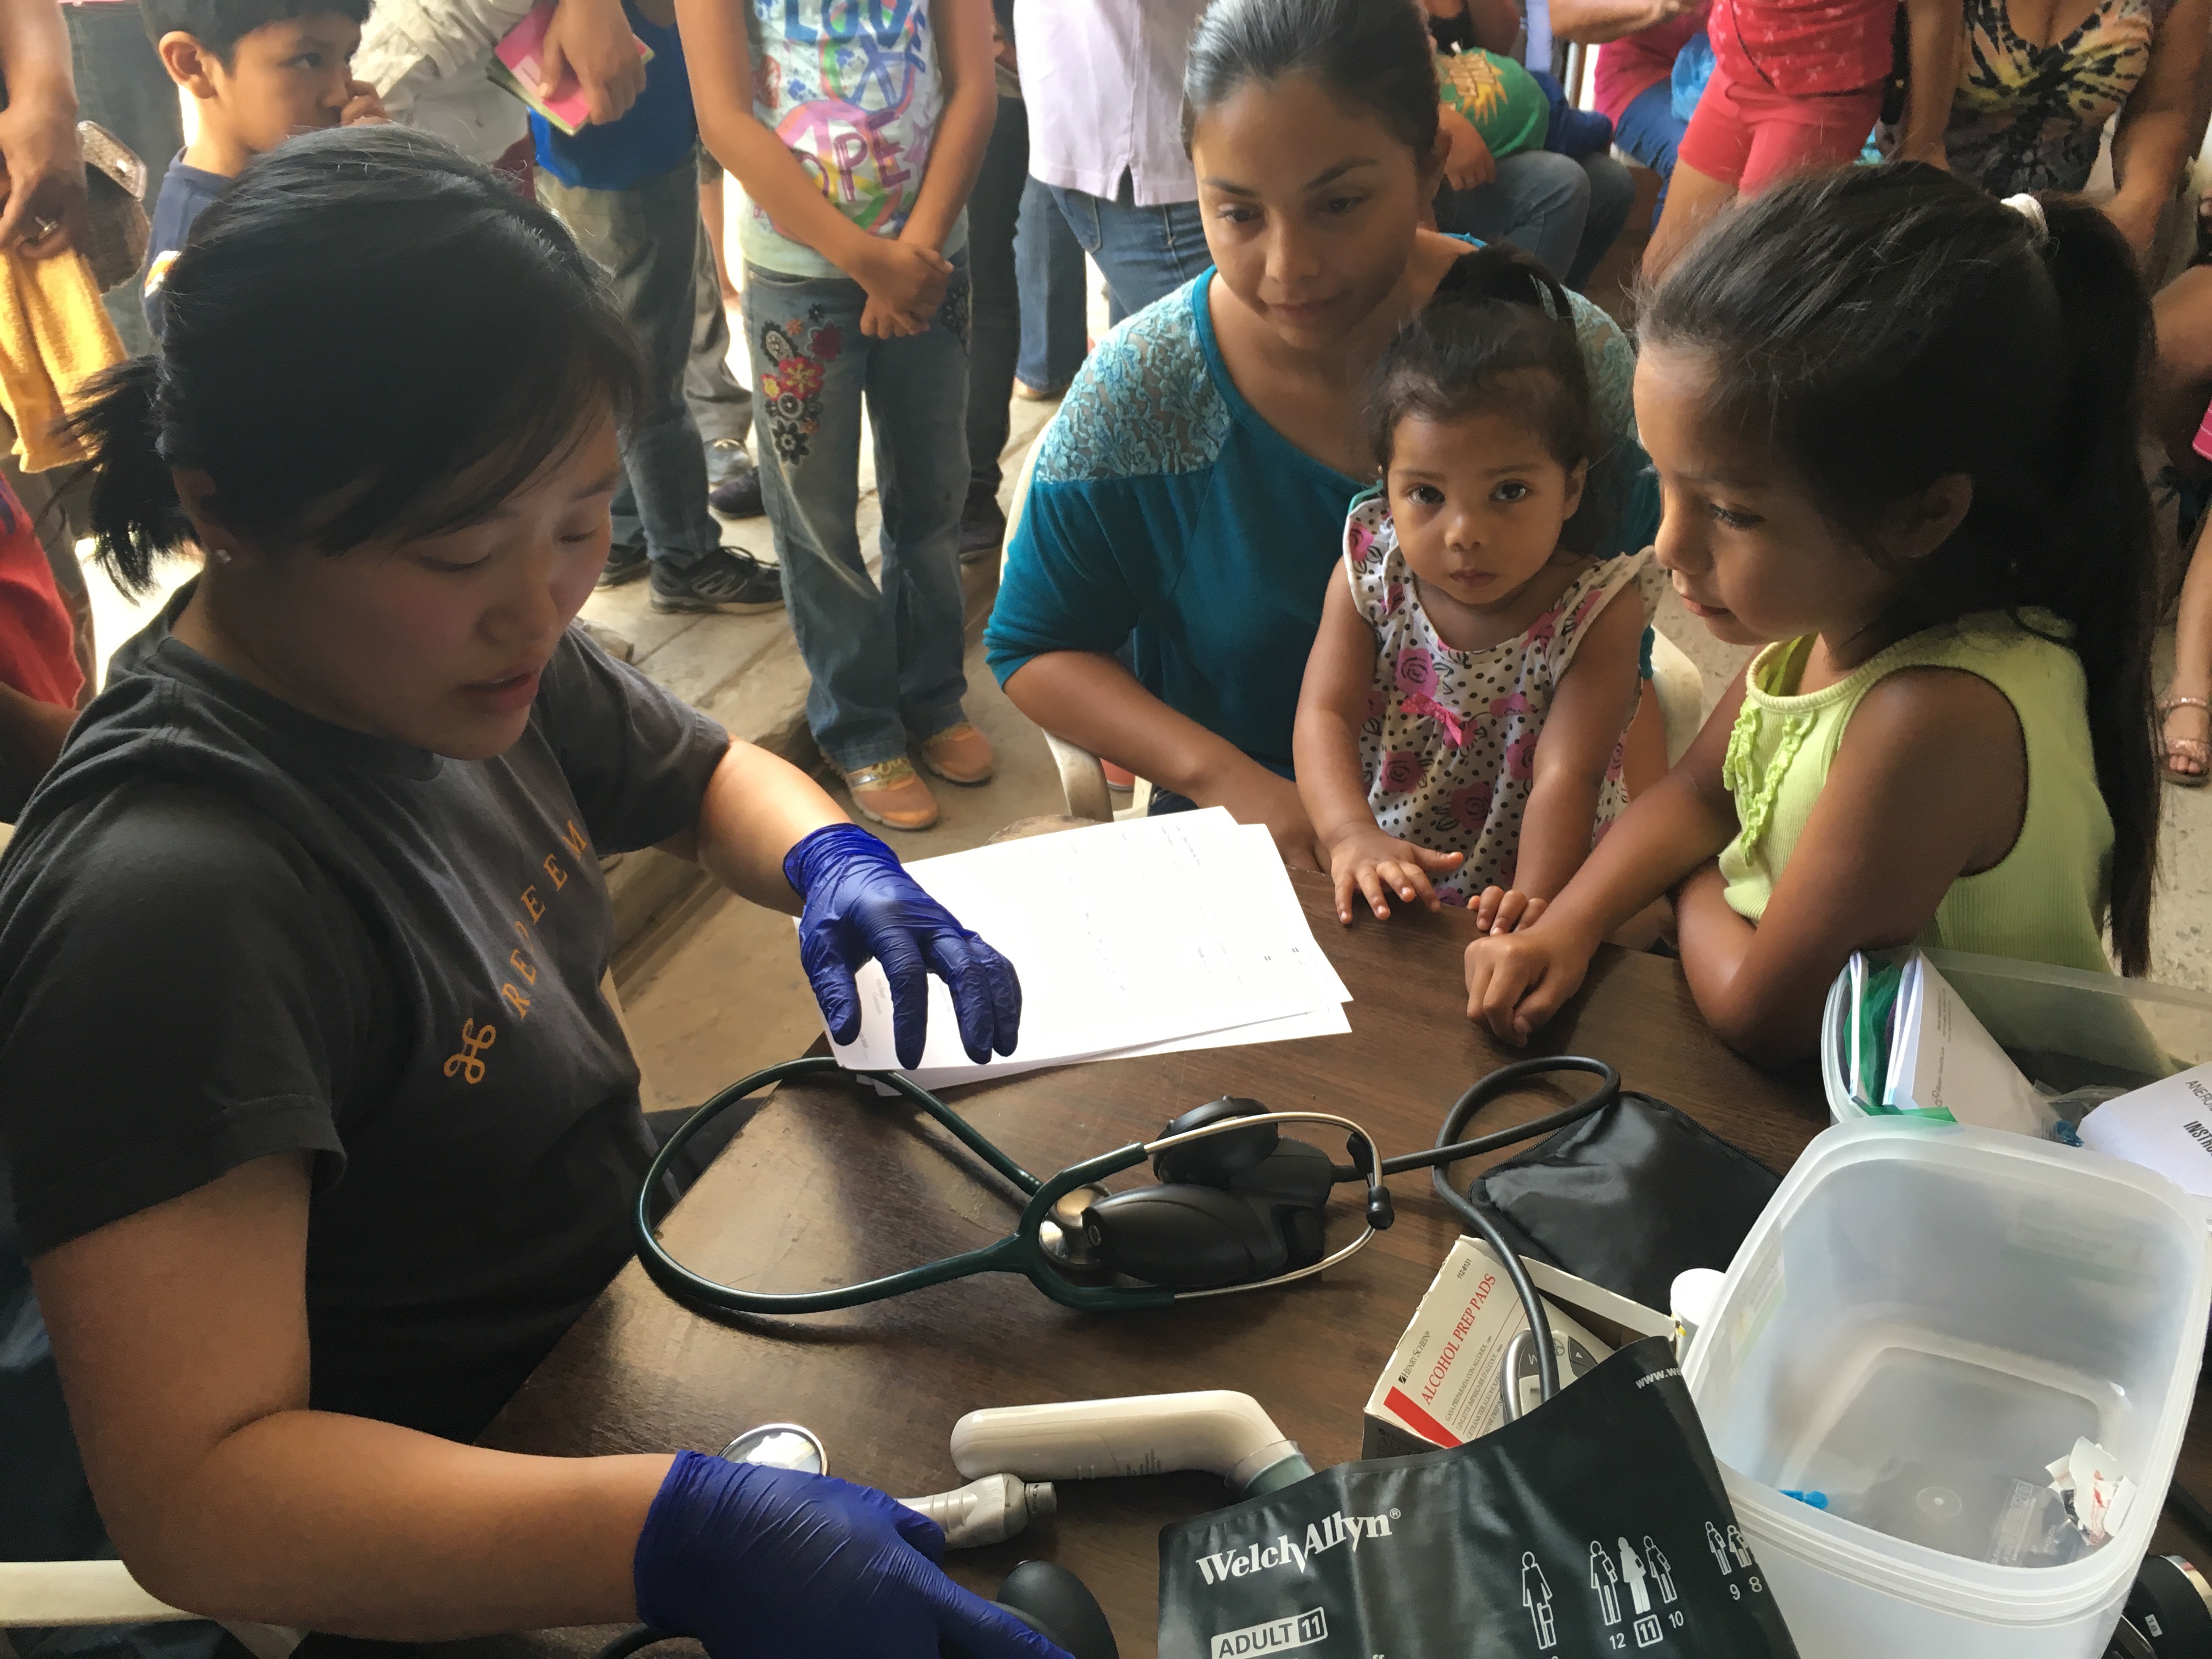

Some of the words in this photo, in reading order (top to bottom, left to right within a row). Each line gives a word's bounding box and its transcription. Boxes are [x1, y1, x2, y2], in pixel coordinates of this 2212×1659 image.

[1457, 1258, 1472, 1279] 112-6131
[1421, 1341, 1460, 1406] ALCOHOL
[1453, 1307, 1476, 1342] PREP
[1469, 1273, 1496, 1311] PADS
[1445, 1406, 1455, 1421] GASA
[1451, 1378, 1470, 1408] PREPARADA
[1466, 1366, 1475, 1379] CON
[1472, 1344, 1487, 1368] ALCOHOL
[1456, 1406, 1471, 1431] LINGETTE
[1729, 1584, 1741, 1600] 9
[1749, 1576, 1762, 1592] 8
[1218, 1622, 1293, 1658] ADULT
[1301, 1615, 1321, 1638] 11
[1610, 1633, 1626, 1650] 12
[1640, 1622, 1656, 1641] 11
[1668, 1611, 1684, 1628] 10
